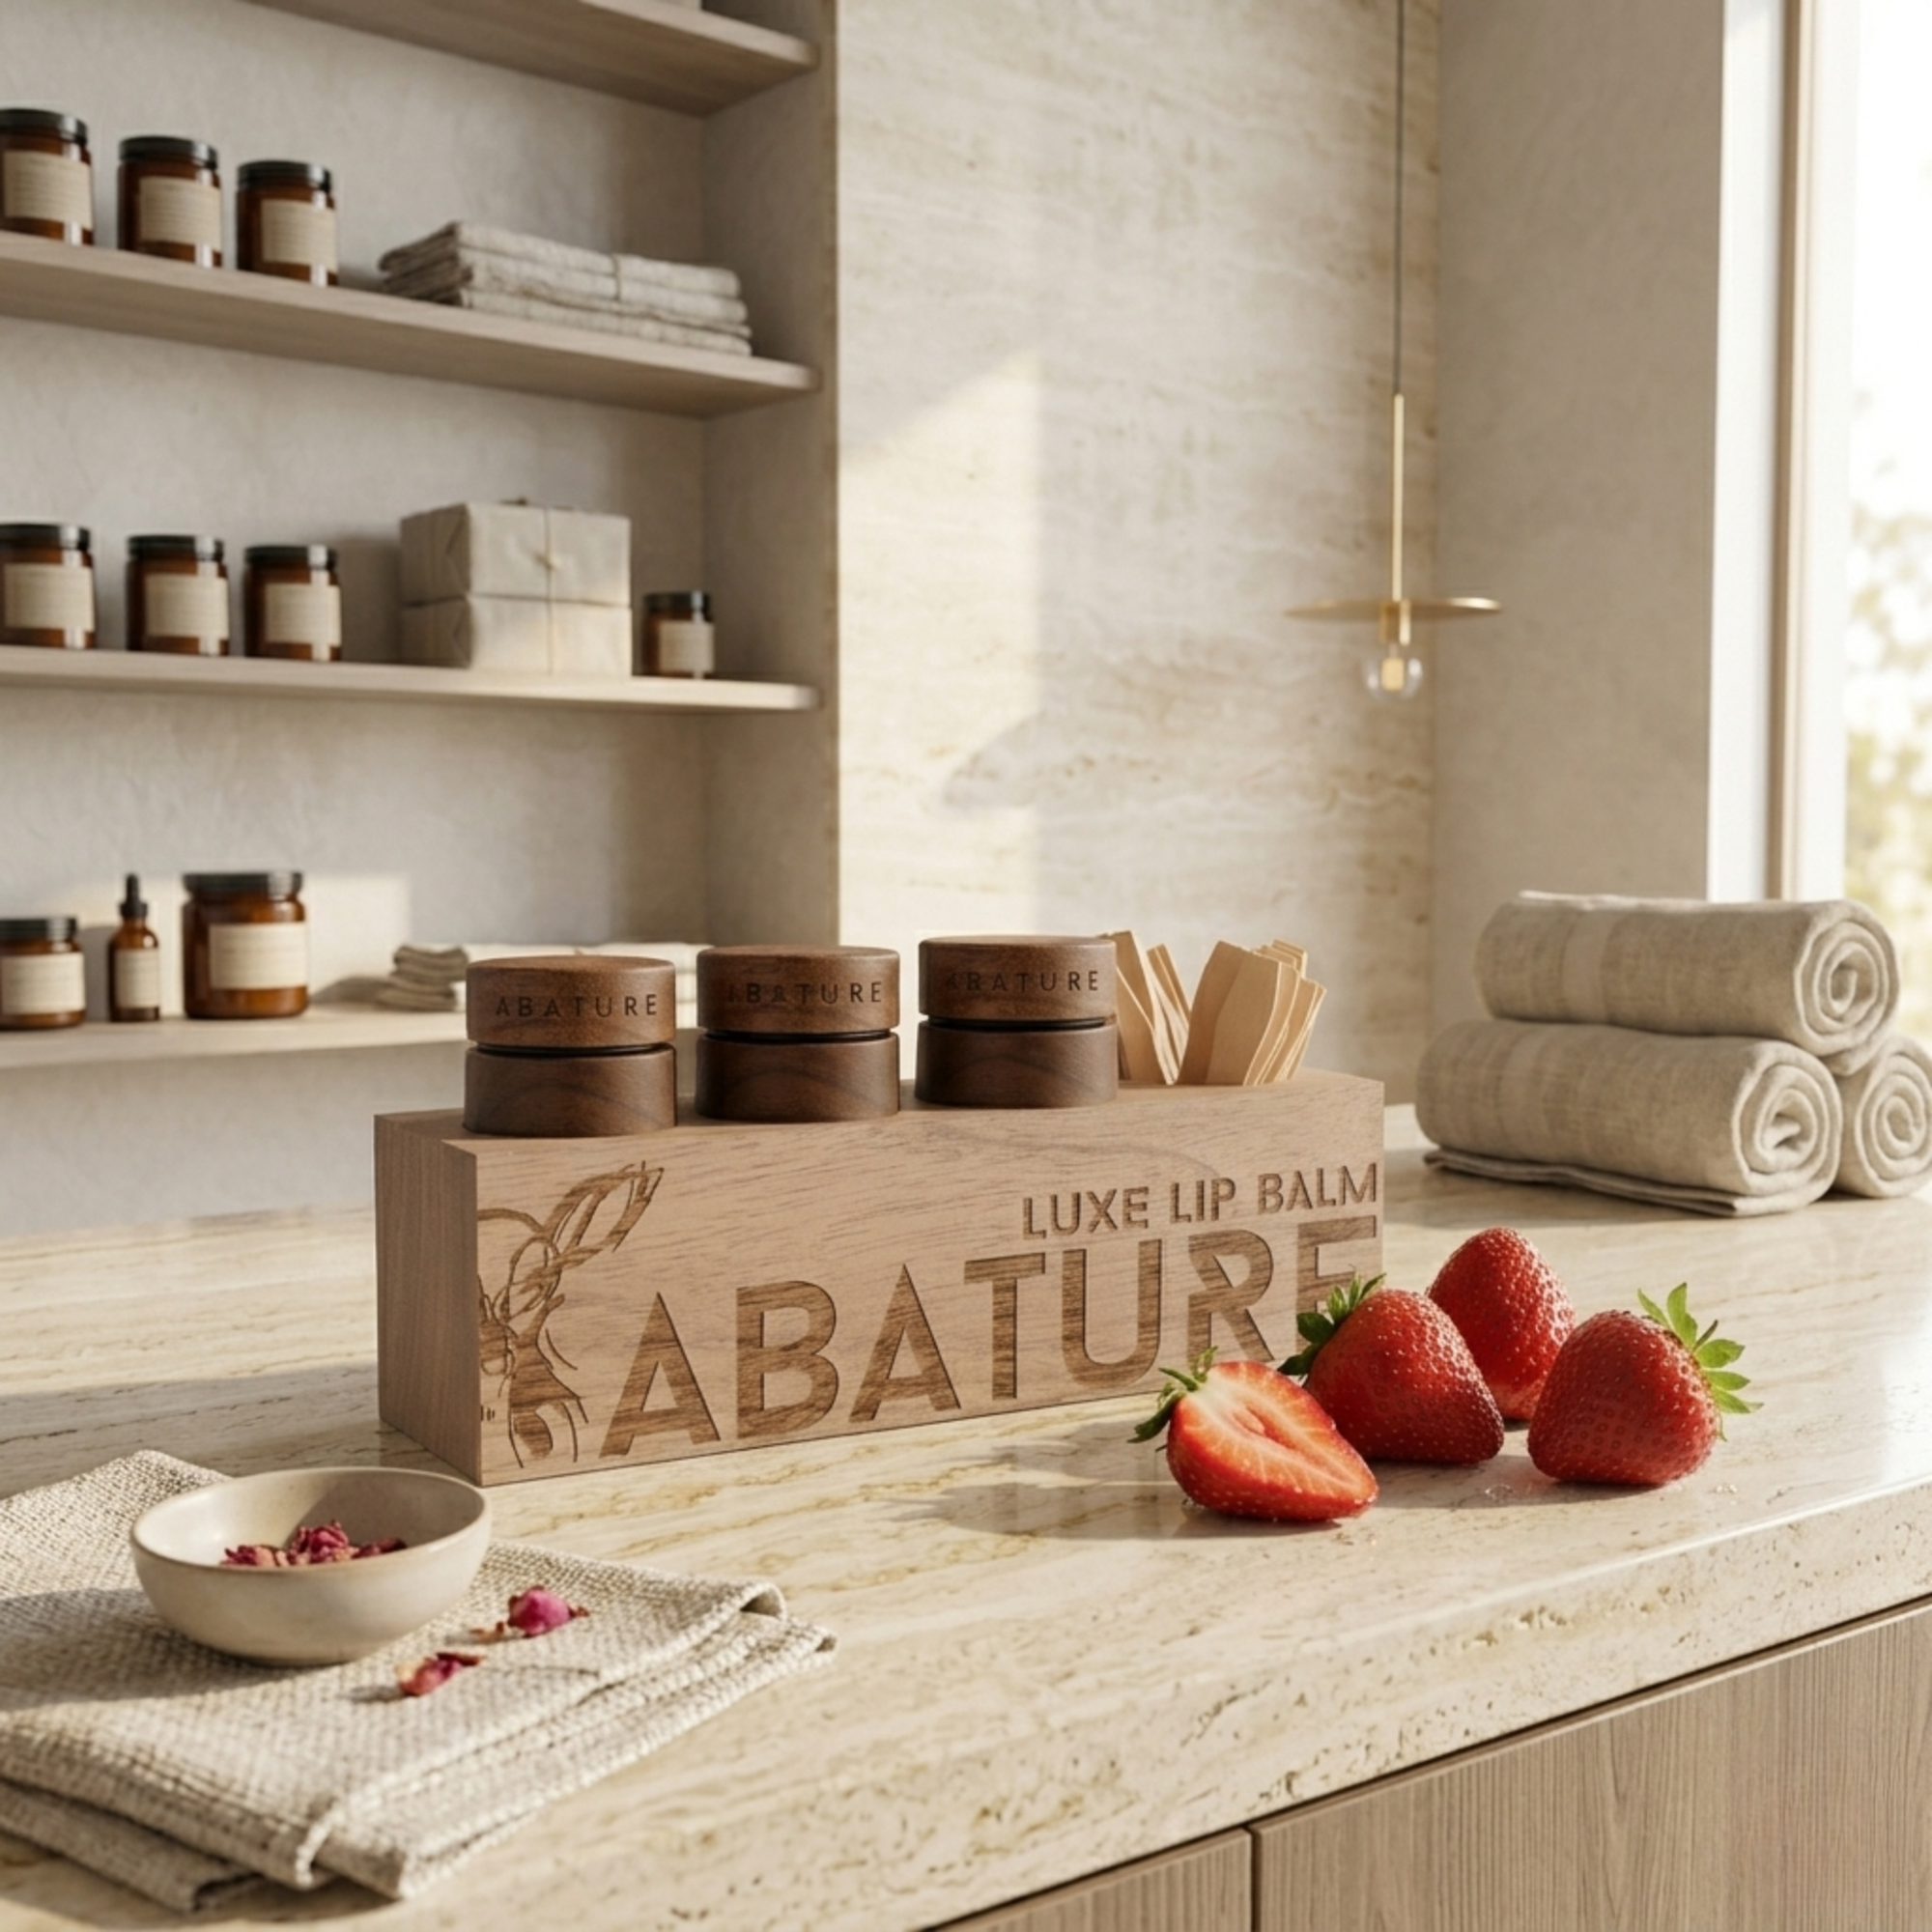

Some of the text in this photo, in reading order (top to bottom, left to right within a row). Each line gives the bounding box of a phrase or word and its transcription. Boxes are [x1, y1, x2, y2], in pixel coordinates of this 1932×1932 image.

[496, 994, 657, 1017] ABATURE
[1022, 1162, 1377, 1240] LUXE LIP BALM
